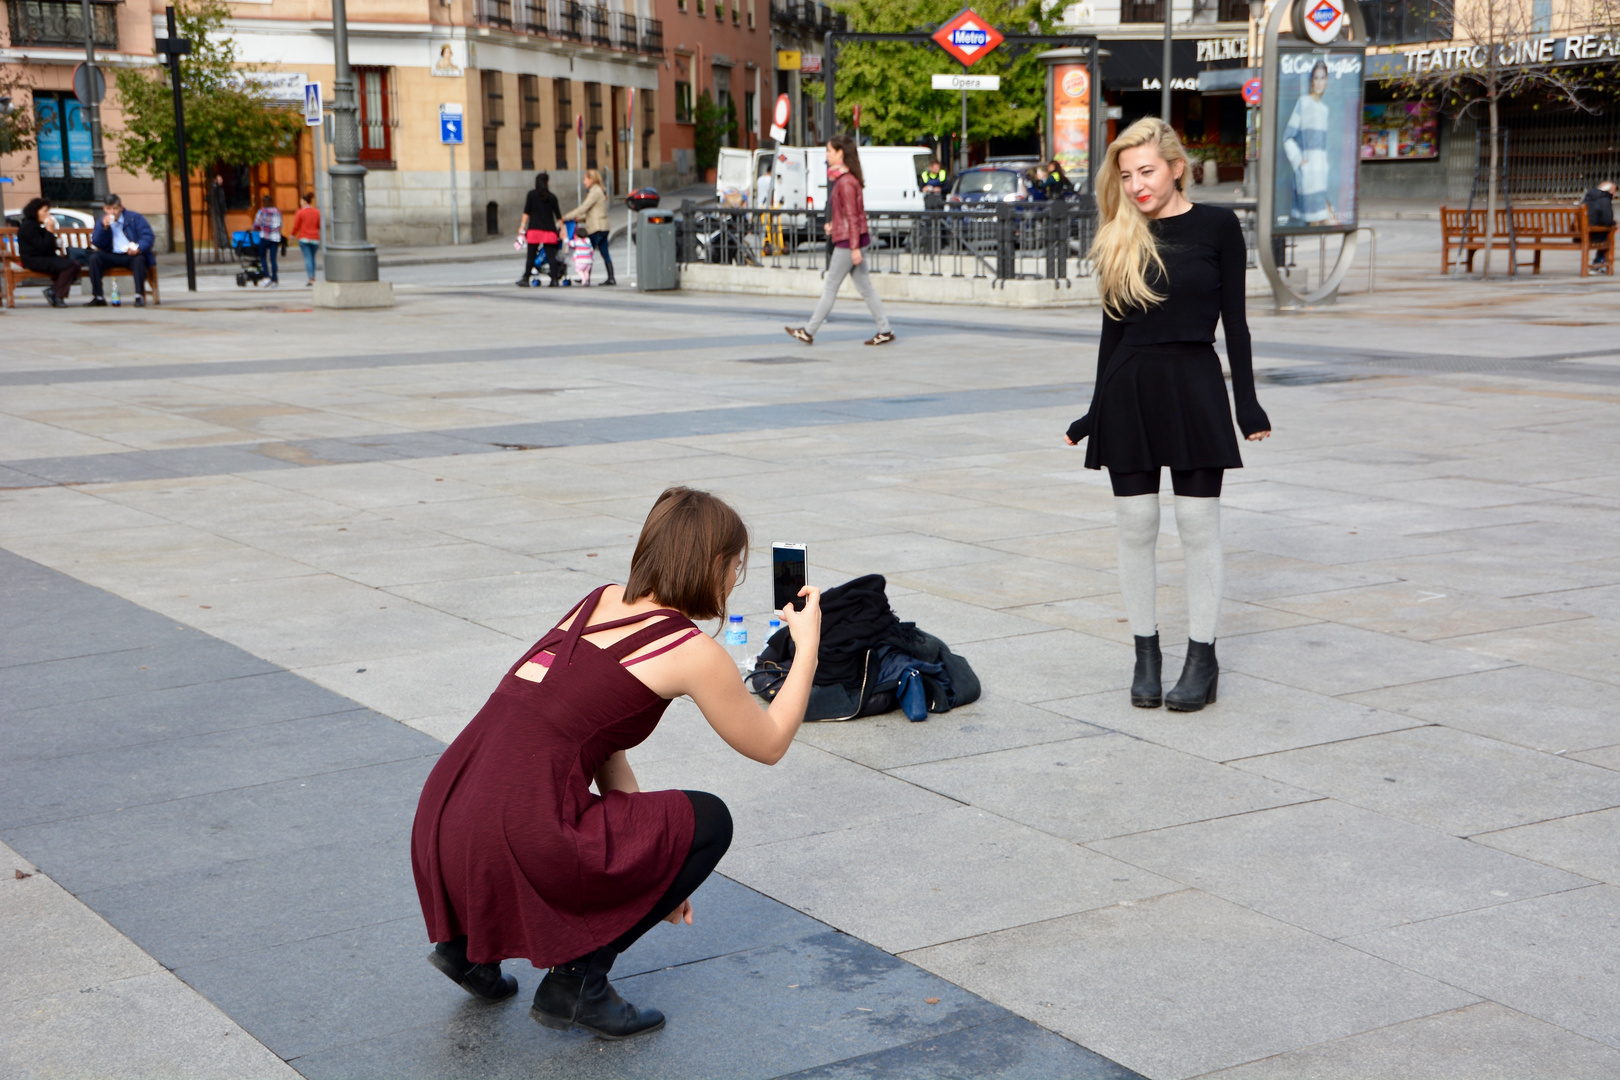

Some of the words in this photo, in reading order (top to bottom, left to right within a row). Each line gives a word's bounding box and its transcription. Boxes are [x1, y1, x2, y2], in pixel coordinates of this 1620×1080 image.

[1314, 9, 1334, 21] Metro
[955, 30, 985, 44] Metro
[1196, 37, 1248, 62] PALACE
[1404, 46, 1488, 73] TEATRO
[1499, 38, 1555, 66] CINE
[1142, 77, 1162, 90] LA
